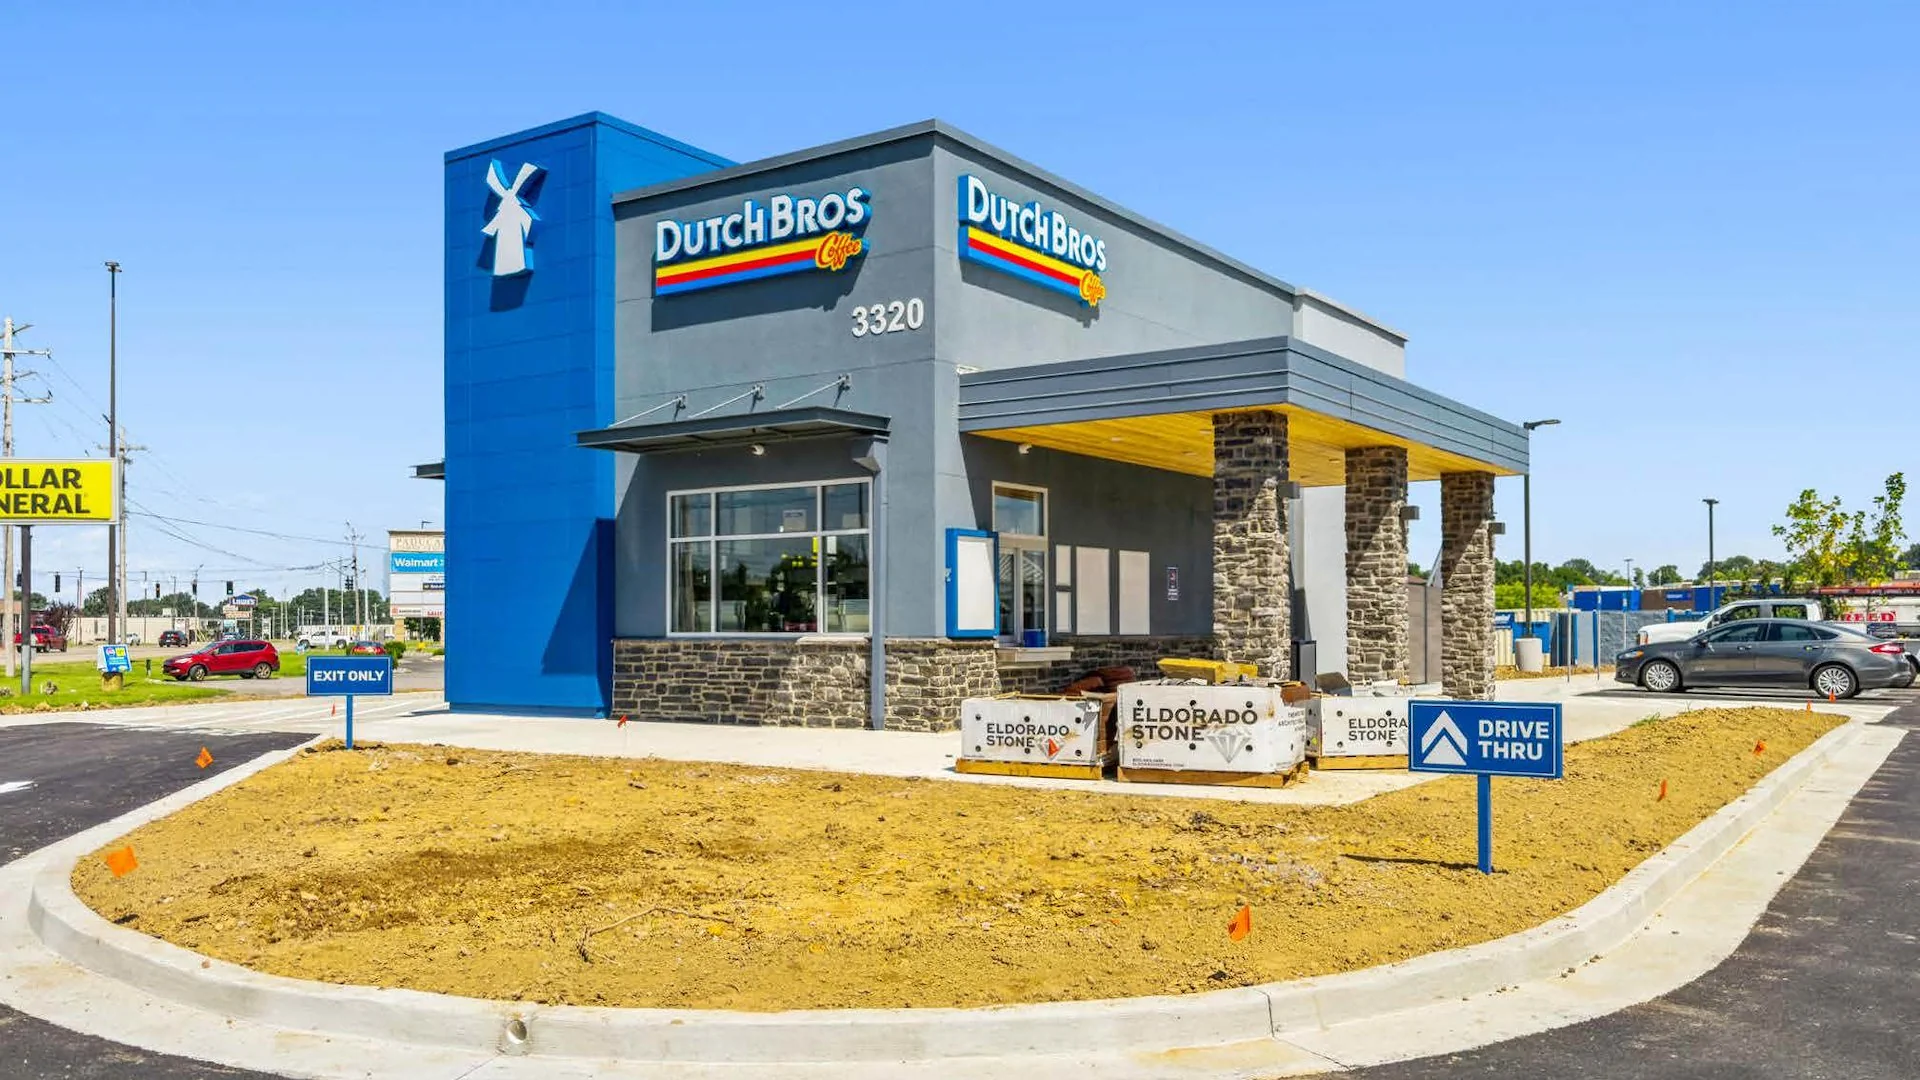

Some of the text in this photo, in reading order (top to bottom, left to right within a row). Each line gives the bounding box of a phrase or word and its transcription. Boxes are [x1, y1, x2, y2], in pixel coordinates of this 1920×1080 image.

[771, 188, 865, 239] BROS
[815, 232, 862, 271] Coffee
[1053, 212, 1107, 271] BROS
[1080, 270, 1106, 306] Coffee
[852, 298, 924, 337] 3320
[0, 468, 82, 489] LLAR
[394, 558, 438, 567] Walmart
[313, 670, 385, 682] EXIT ONLY
[1132, 707, 1258, 725] ELDORADO
[987, 723, 1070, 737] ELDORADO
[1132, 724, 1205, 741] STONE
[1348, 730, 1397, 741] STONE
[1478, 719, 1550, 740] DRIVE
[986, 735, 1035, 748] STONE
[1478, 741, 1543, 761] THRU
